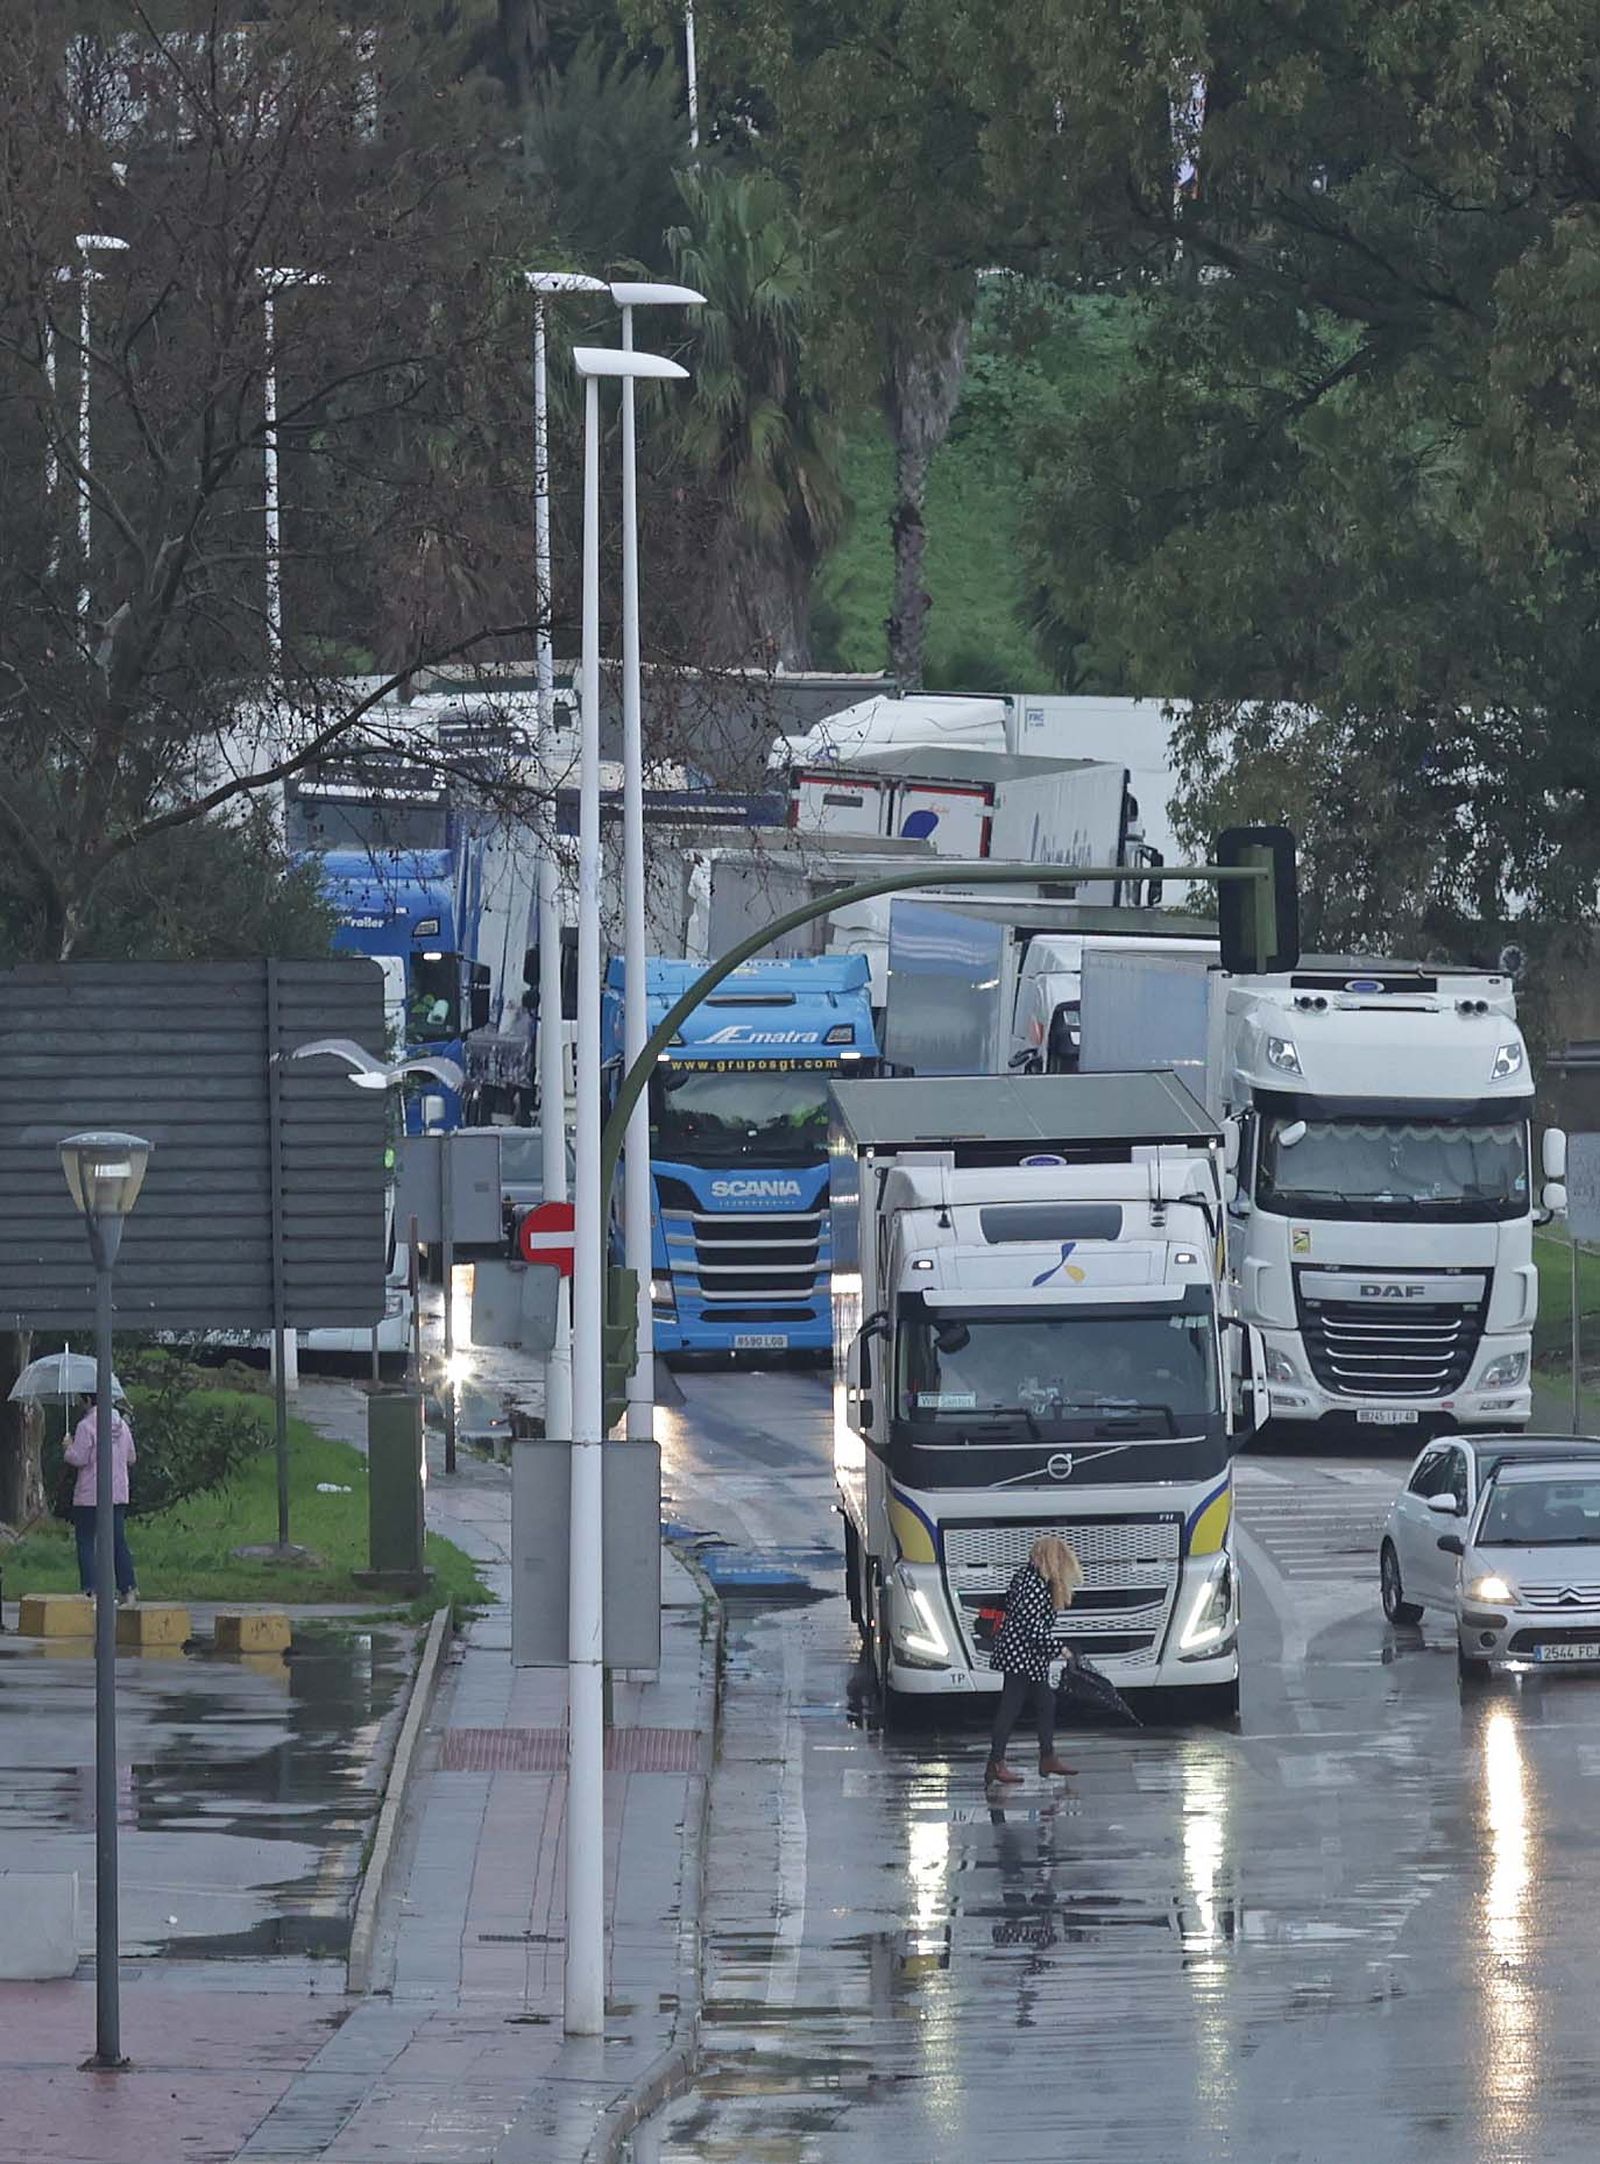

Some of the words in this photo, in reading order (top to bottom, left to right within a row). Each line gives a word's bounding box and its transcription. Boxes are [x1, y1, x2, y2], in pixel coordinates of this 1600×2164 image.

[711, 1181, 801, 1196] SCANIA
[1360, 1285, 1425, 1298] DAF
[1544, 1647, 1574, 1659] 2544
[951, 1673, 965, 1684] TP
